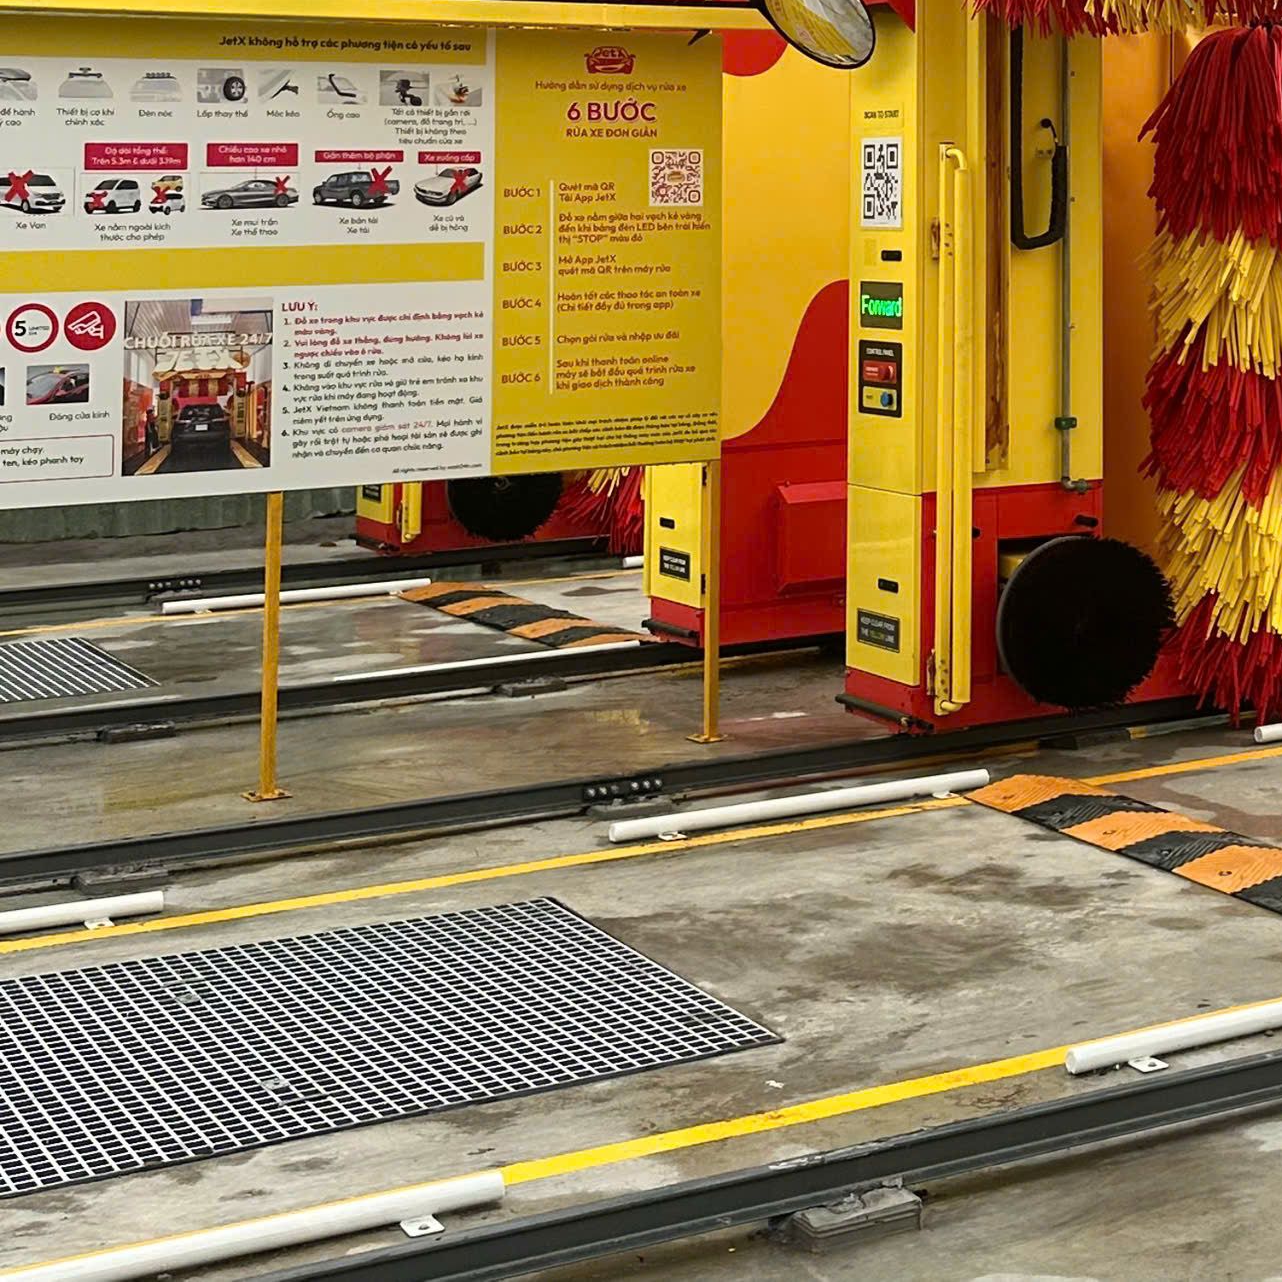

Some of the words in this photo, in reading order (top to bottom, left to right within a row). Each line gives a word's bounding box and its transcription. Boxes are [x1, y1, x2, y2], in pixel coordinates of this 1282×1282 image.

[220, 37, 246, 46] JetX
[249, 37, 282, 48] không
[321, 39, 337, 48] các
[453, 43, 471, 51] sau
[568, 102, 580, 121] 6
[588, 98, 656, 121] BƯỚC
[566, 126, 588, 137] RỬA
[590, 129, 604, 137] XE
[606, 128, 629, 137] ĐƠN
[504, 186, 534, 198] BƯỚC
[537, 189, 541, 198] 1
[600, 182, 614, 191] QR
[574, 194, 593, 203] App
[595, 193, 616, 202] JetX
[504, 224, 534, 235] BƯỚC
[536, 225, 542, 234] 2
[575, 256, 593, 265] App
[595, 254, 616, 264] JetX
[503, 261, 533, 272] BƯỚC
[536, 262, 541, 270] 3
[598, 265, 612, 274] QR
[502, 298, 533, 309] BƯỚC
[535, 299, 541, 307] 4
[862, 295, 902, 317] Forward
[14, 320, 27, 336] 5
[502, 335, 533, 346] BƯỚC
[535, 336, 541, 345] 5
[642, 355, 668, 364] online
[502, 372, 532, 384] BƯỚC
[534, 374, 541, 382] 6
